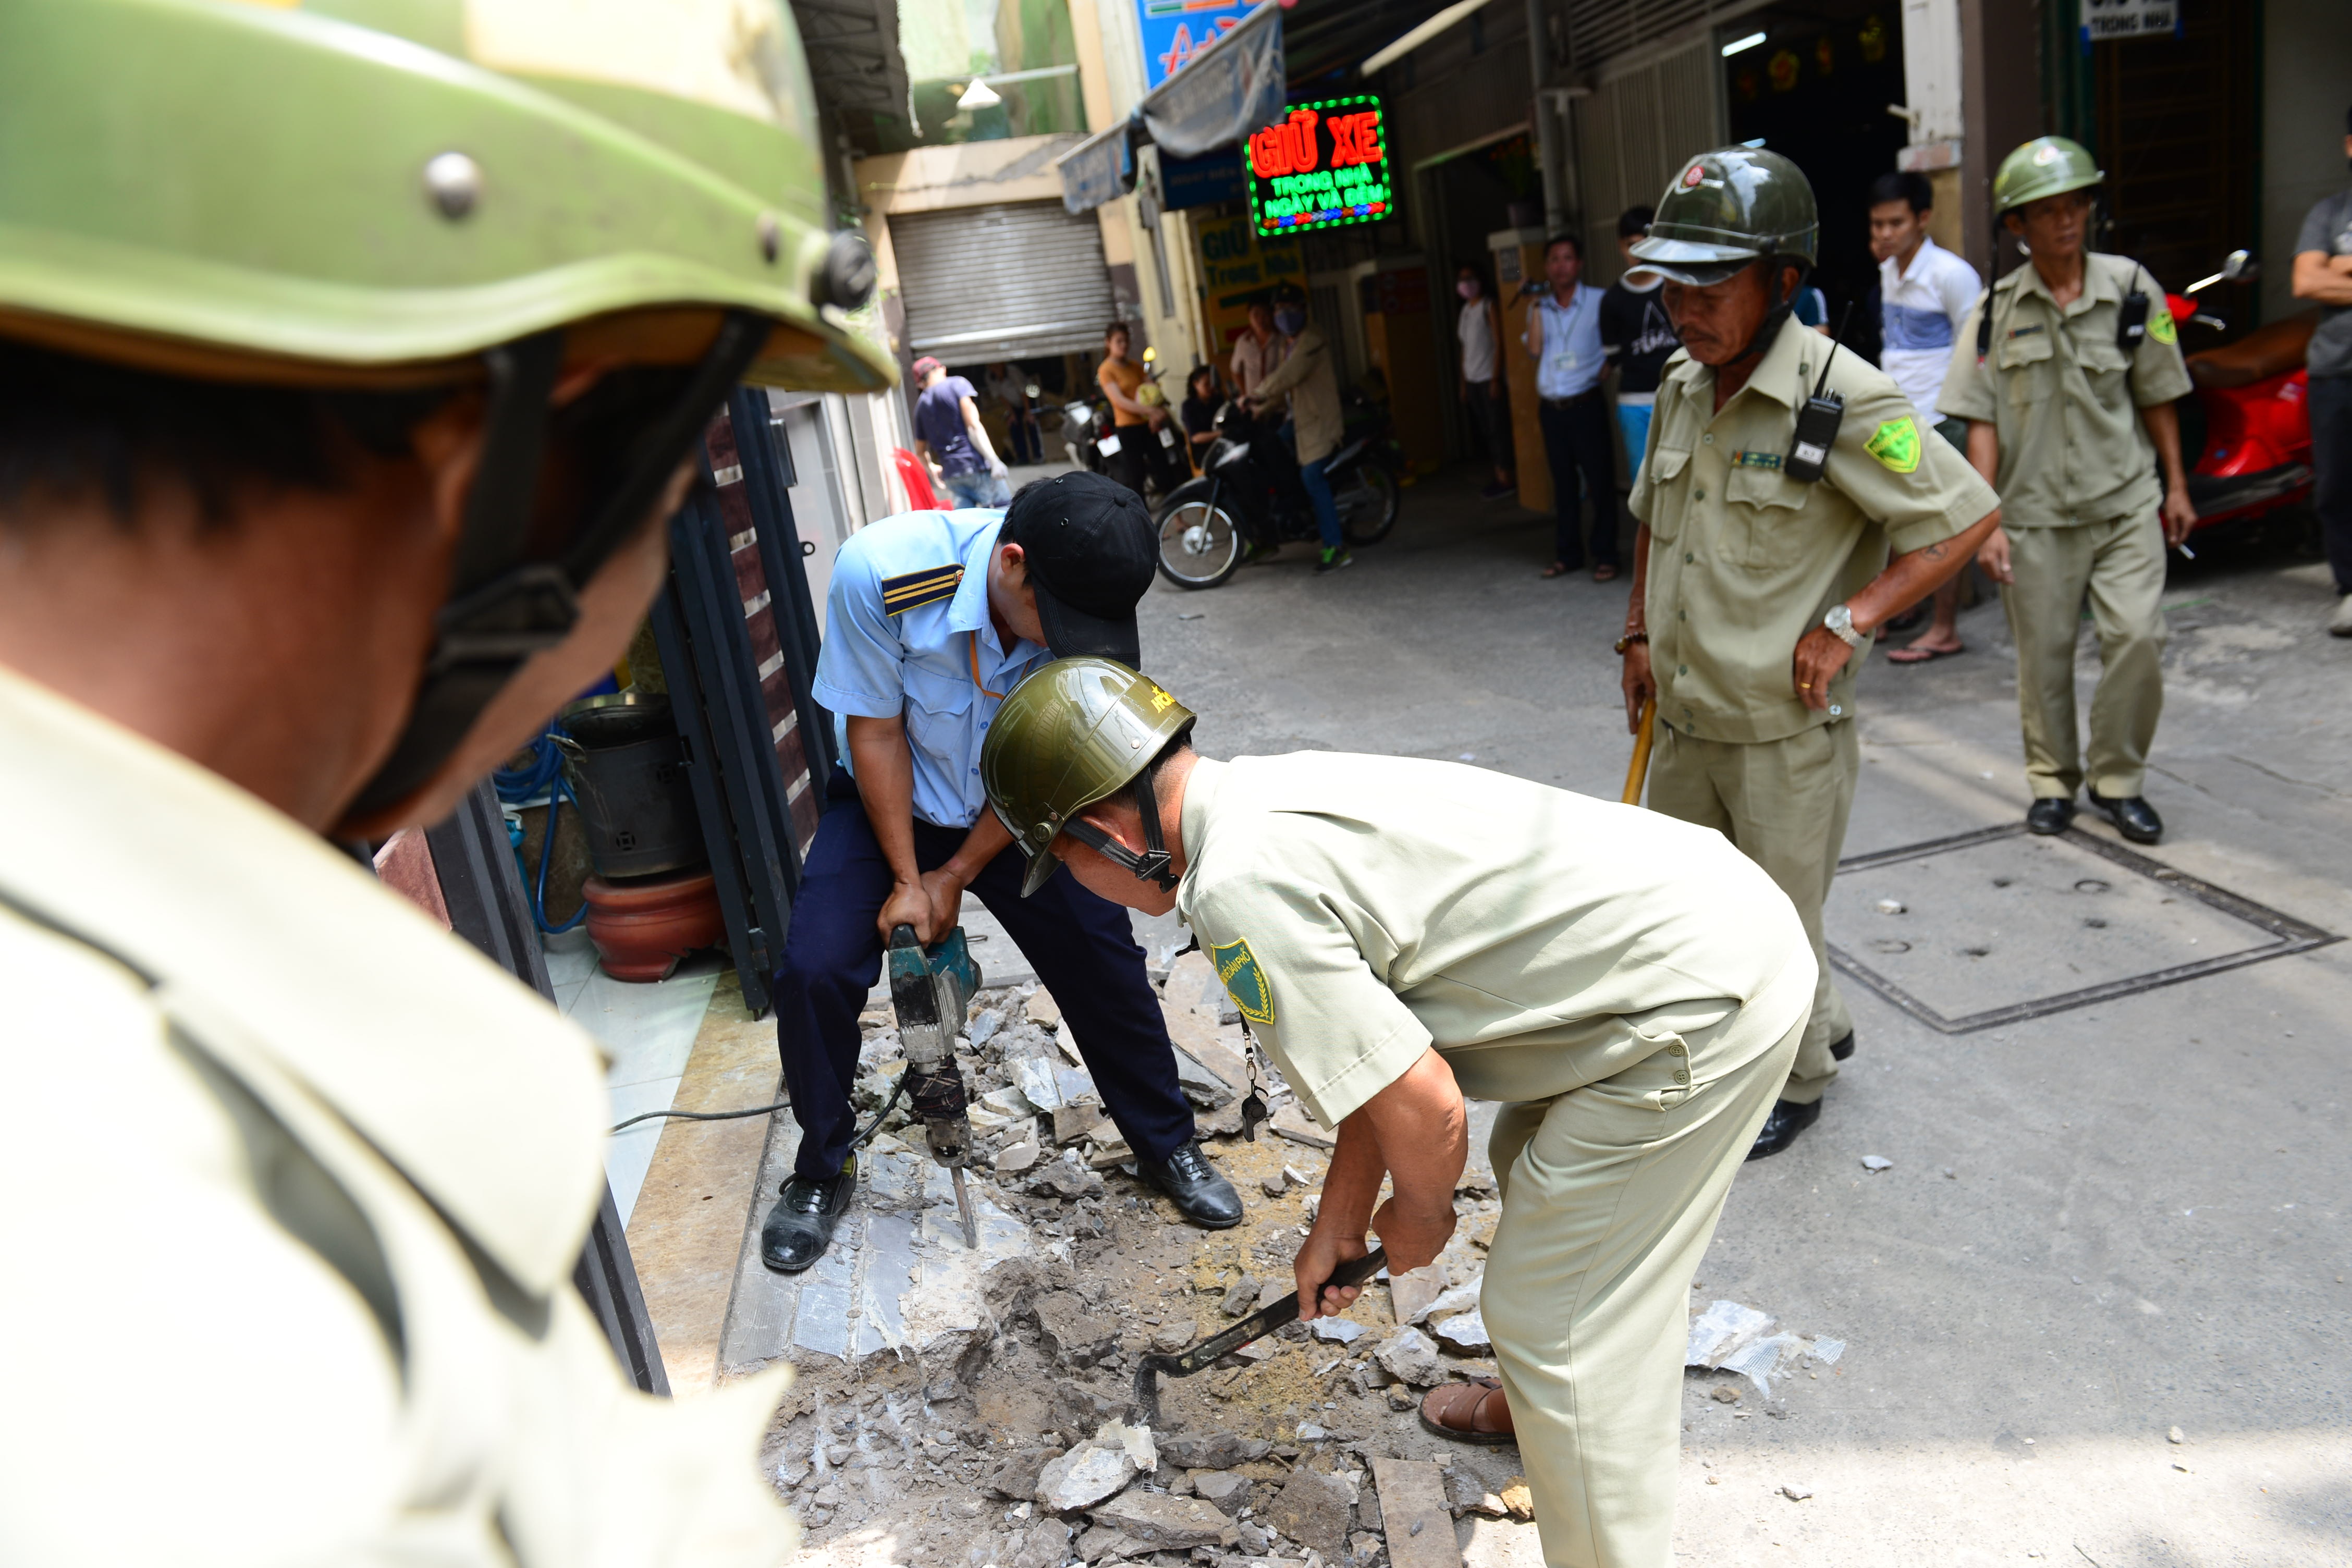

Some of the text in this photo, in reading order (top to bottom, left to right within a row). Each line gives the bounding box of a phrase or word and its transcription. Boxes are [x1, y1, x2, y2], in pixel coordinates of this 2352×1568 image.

[1249, 108, 1383, 178] GIỮ XE
[1271, 170, 1333, 197] TRONG
[1334, 162, 1373, 188] NHÀ
[1265, 191, 1315, 219] NGÀY
[1317, 187, 1343, 210] VÀ
